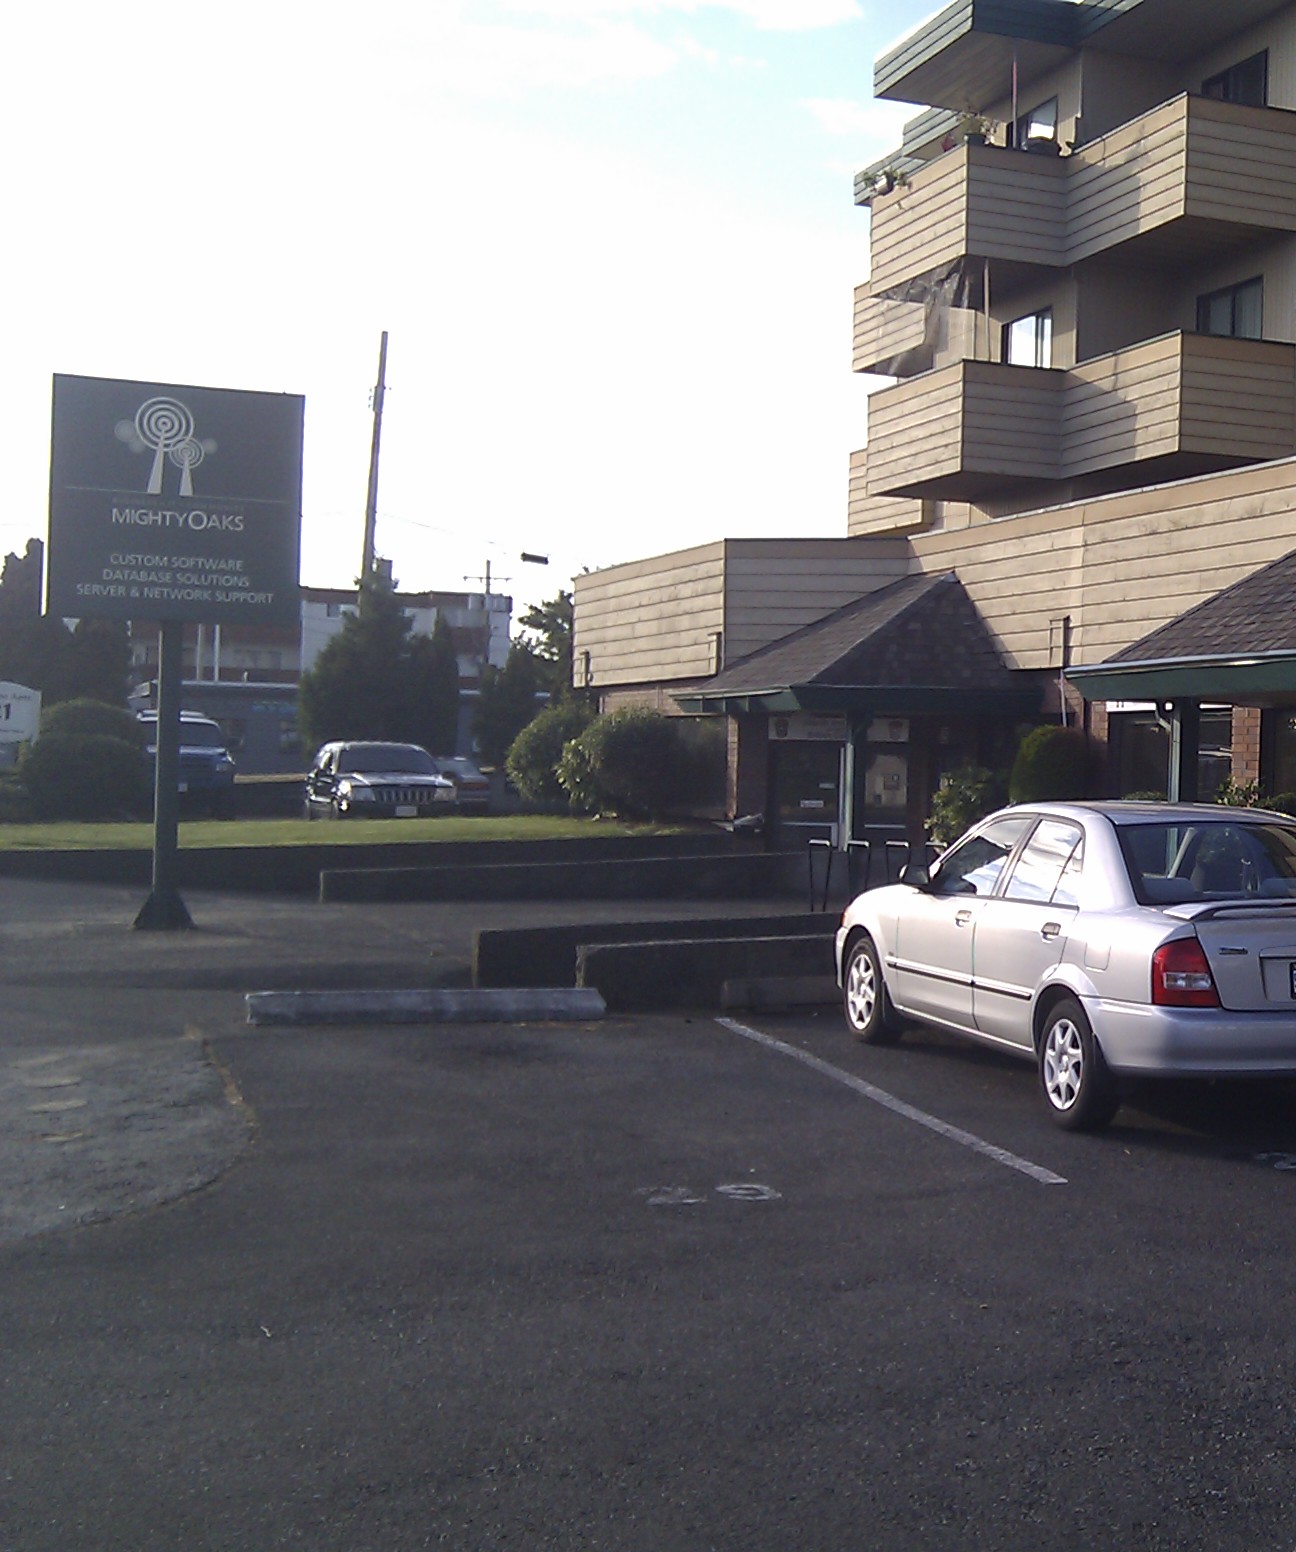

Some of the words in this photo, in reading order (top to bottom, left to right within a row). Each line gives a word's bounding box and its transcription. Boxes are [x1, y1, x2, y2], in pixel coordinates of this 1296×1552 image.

[111, 508, 245, 531] MIGHTYOAKS
[110, 553, 168, 567] CUSTOM
[171, 556, 244, 571] SOFTWARE
[102, 568, 172, 583] DATABASE
[176, 572, 249, 587] SOLUTIONS
[76, 583, 126, 596] SERVER
[129, 587, 139, 598] &
[144, 588, 212, 601] NETWORK
[216, 592, 274, 604] SUPPORT
